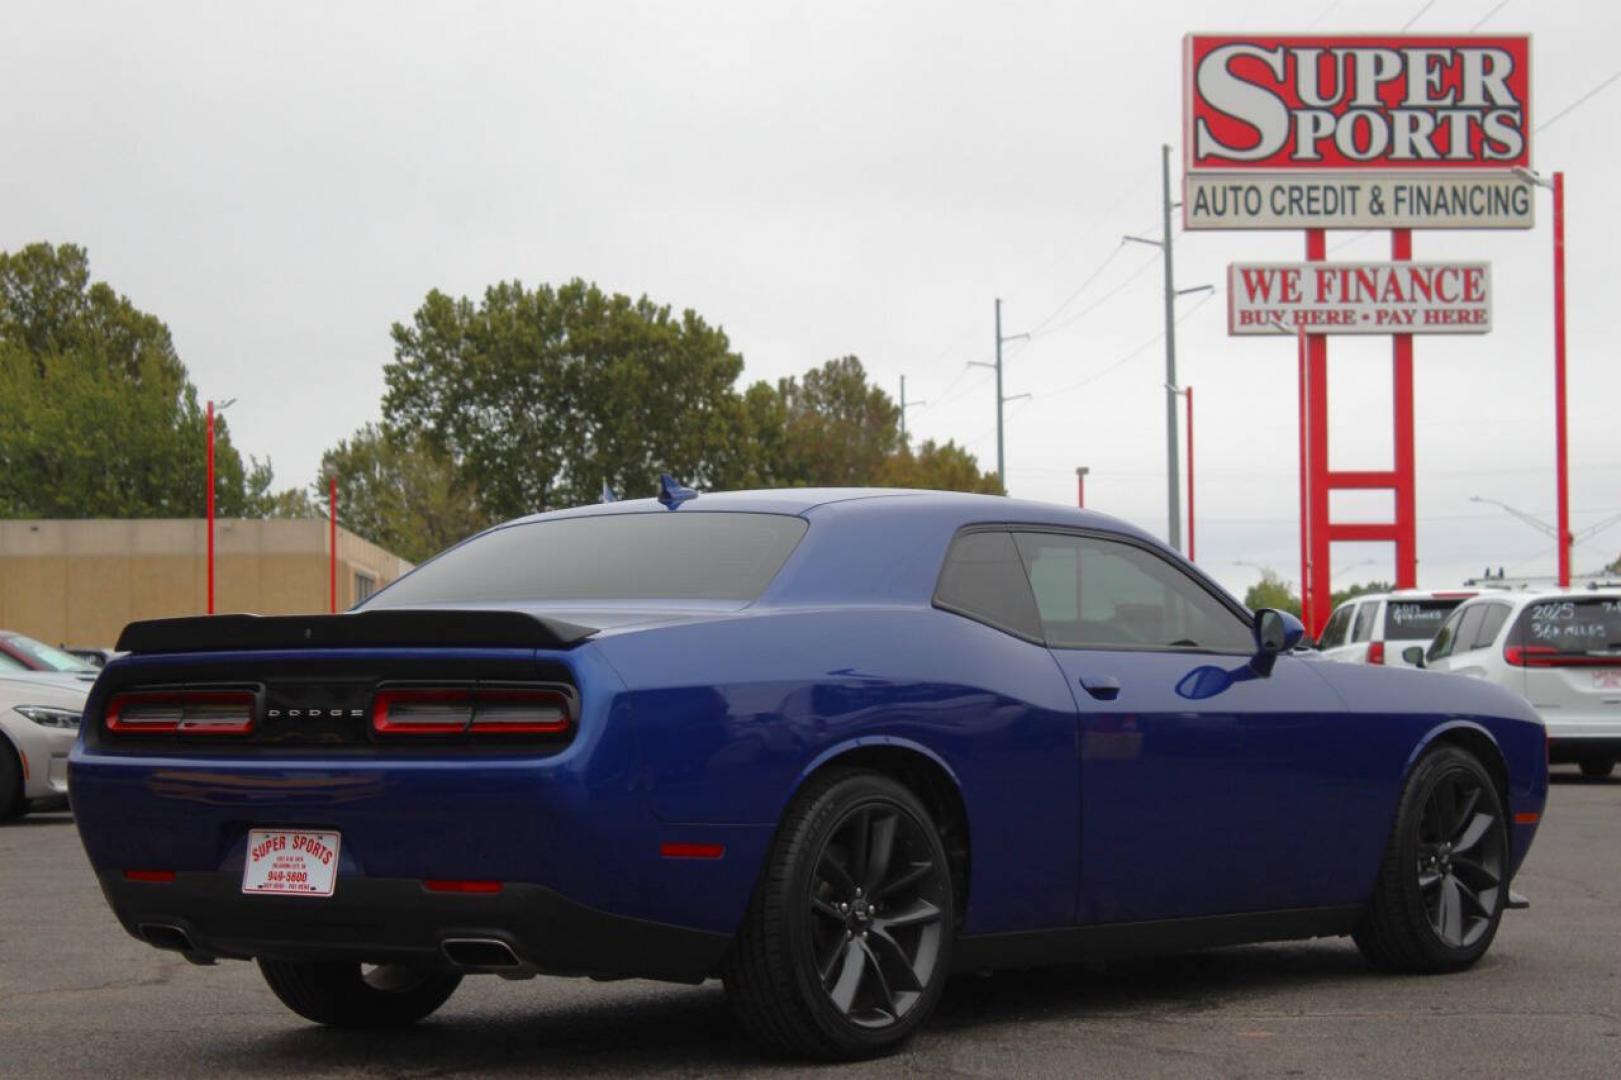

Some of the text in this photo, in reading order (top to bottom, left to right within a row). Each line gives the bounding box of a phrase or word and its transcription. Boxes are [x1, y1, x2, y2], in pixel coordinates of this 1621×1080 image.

[1197, 43, 1520, 162] SUPER
[1193, 185, 1530, 217] AUTO CREDIT & FINANCING
[1240, 267, 1486, 304] WE FINANCE
[1239, 308, 1488, 326] BUY HERE PAY HERE
[1532, 602, 1575, 620] 2025
[268, 709, 364, 717] DODGE
[252, 834, 333, 865] SUPER SPORTS
